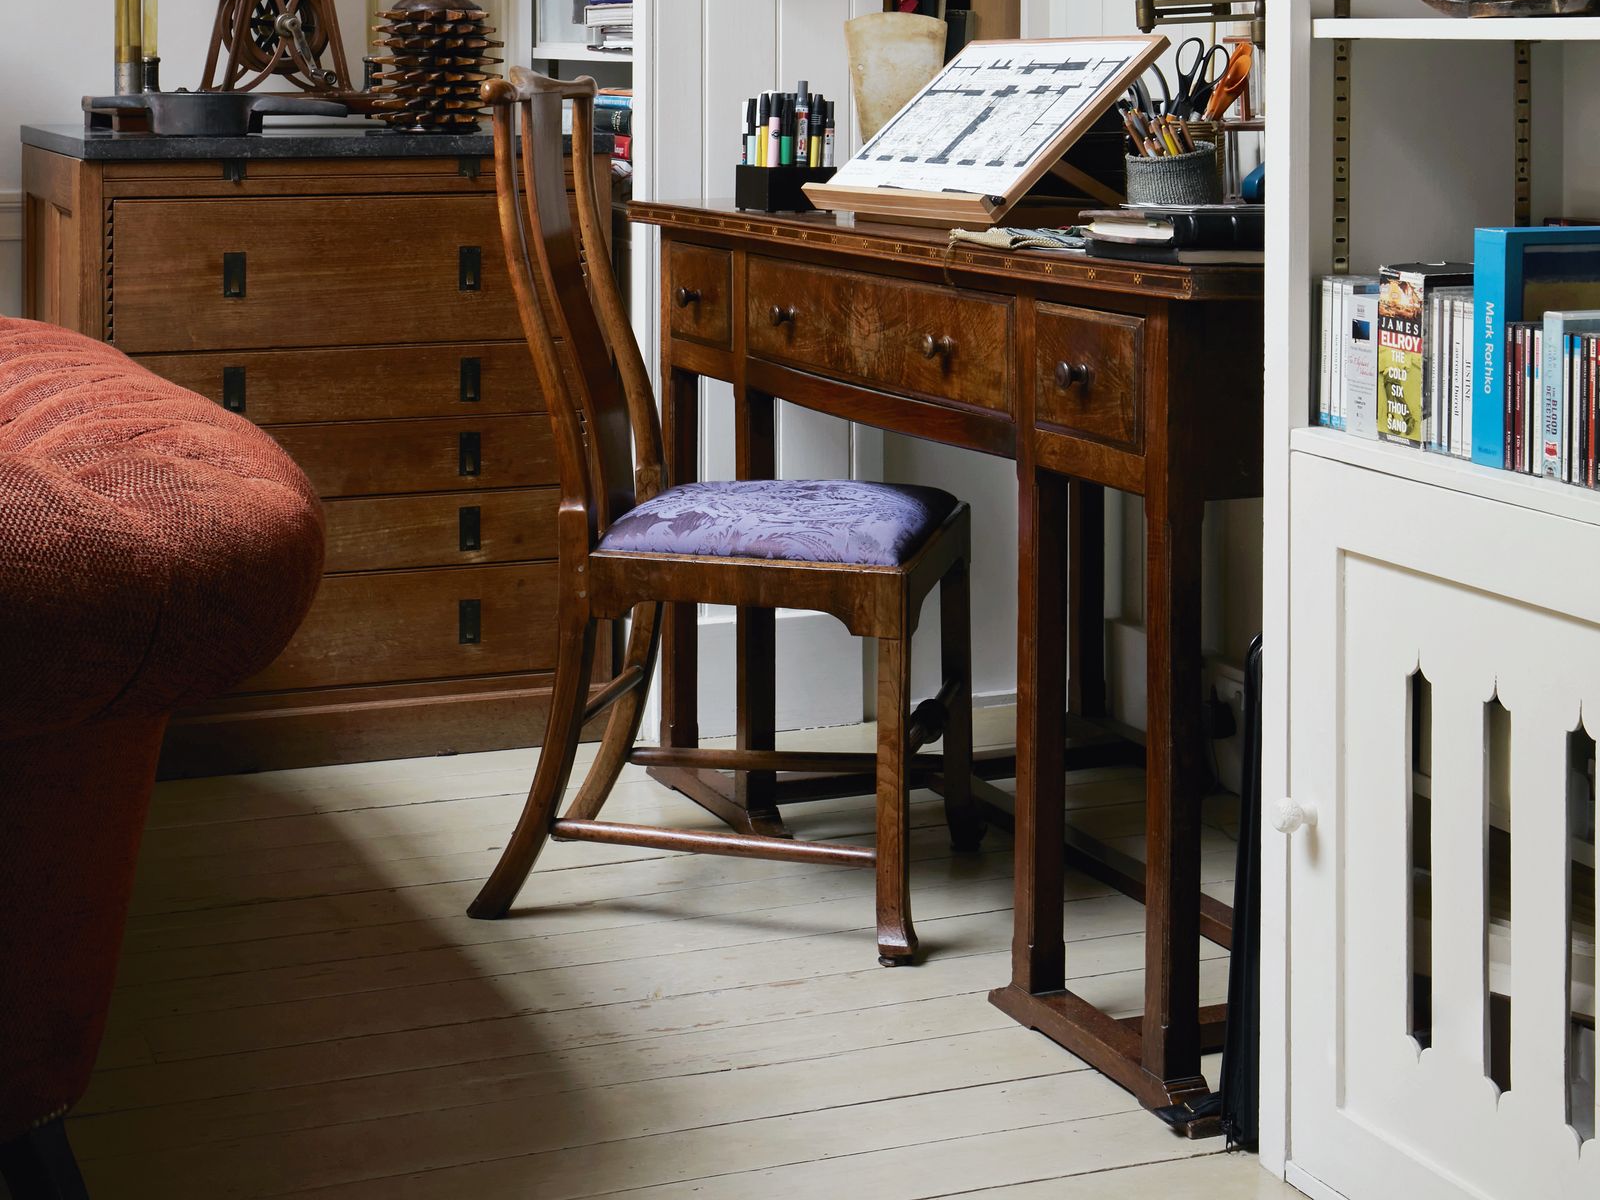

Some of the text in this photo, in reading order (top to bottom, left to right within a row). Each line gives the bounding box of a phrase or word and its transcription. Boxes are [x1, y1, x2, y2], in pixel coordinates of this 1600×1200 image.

[1381, 317, 1419, 336] JAMES
[1381, 330, 1420, 352] ELLROY
[1484, 301, 1495, 394] Mark Rothko
[1391, 350, 1405, 364] THE
[1388, 366, 1407, 381] COLD
[1391, 384, 1404, 398] SIX
[1387, 400, 1410, 416] THOU-
[1387, 418, 1407, 433] SAND
